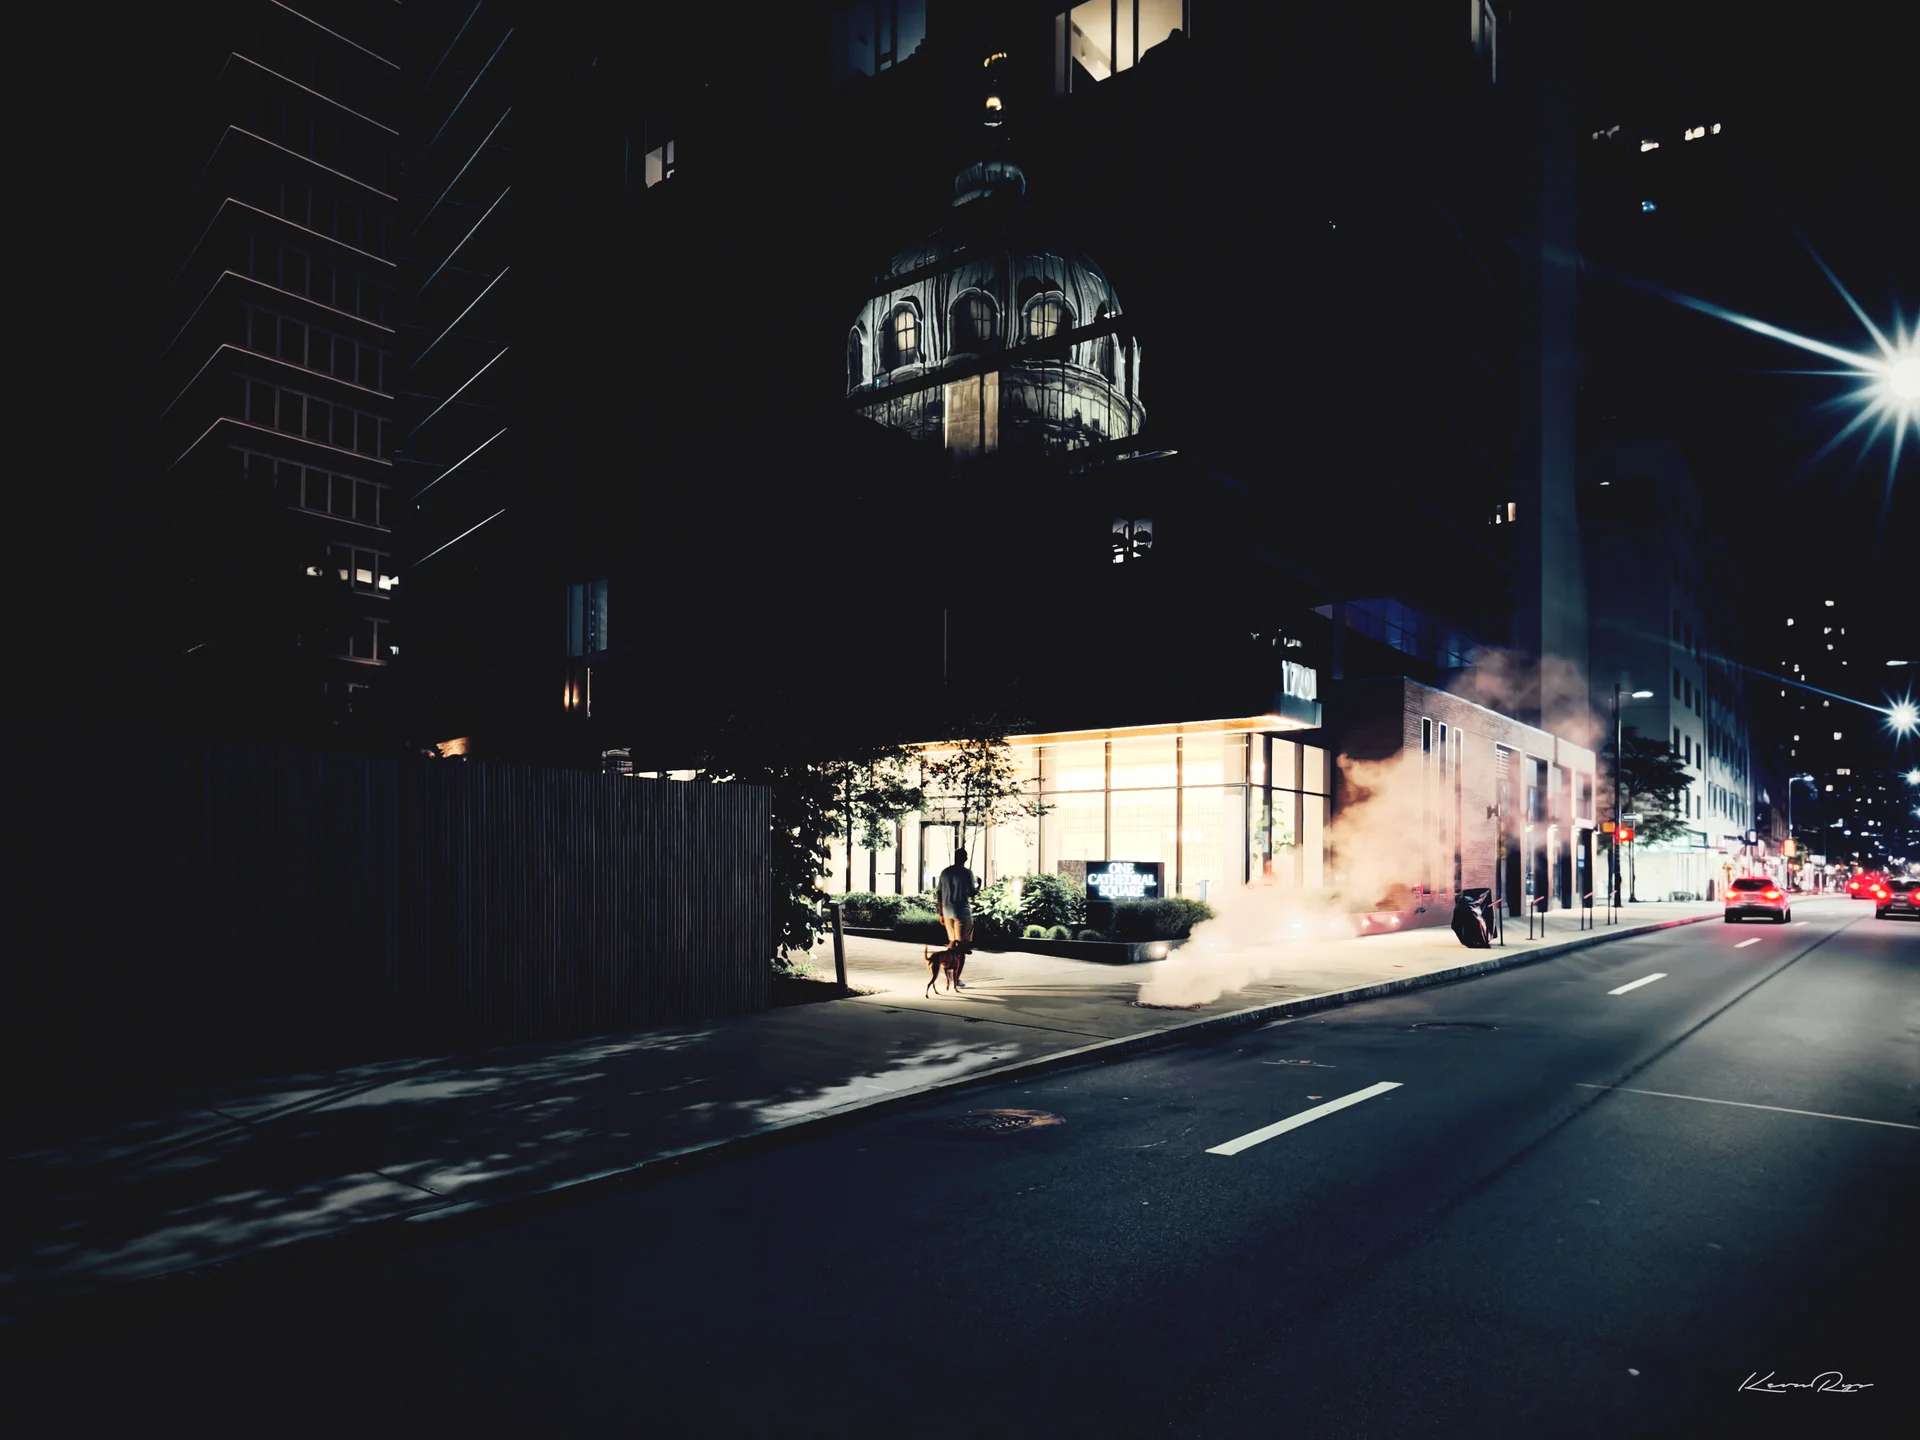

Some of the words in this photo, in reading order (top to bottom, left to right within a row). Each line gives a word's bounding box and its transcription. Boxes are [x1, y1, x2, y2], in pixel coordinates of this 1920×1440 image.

[1108, 862, 1135, 874] ONE
[1087, 873, 1157, 886] CATHEDRAL
[1099, 885, 1145, 899] SQUARE
